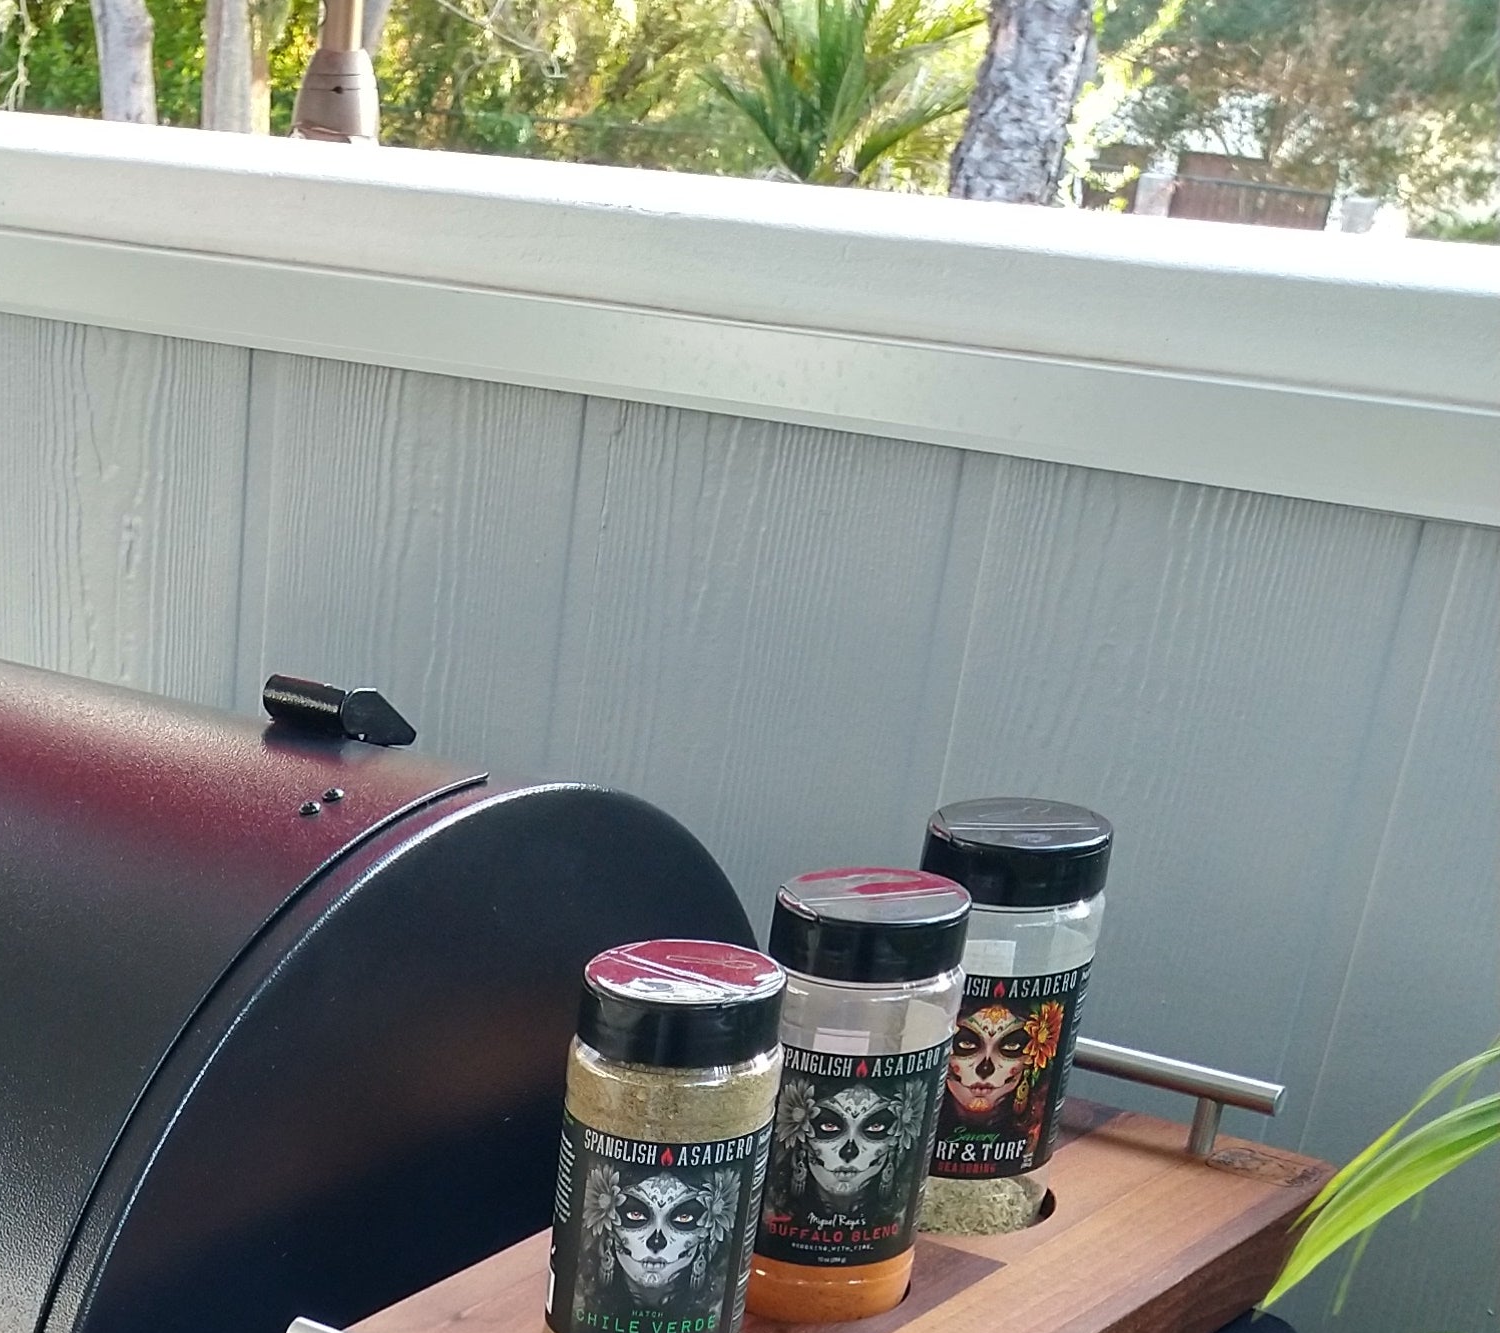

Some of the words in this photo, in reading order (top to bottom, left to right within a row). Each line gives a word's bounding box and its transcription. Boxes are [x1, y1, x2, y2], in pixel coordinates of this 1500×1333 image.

[962, 976, 991, 998] ISH
[1008, 970, 1078, 998] ASADERO
[782, 1047, 853, 1078] PANGLISH
[871, 1047, 941, 1078] ASADERO
[584, 1129, 657, 1166] SPANGLISH
[677, 1135, 754, 1167] ASADERO
[935, 1140, 960, 1161] RF
[961, 1143, 976, 1161] &
[982, 1139, 1027, 1161] TURF
[768, 1222, 844, 1243] BUFFALO
[851, 1222, 900, 1243] BLEND
